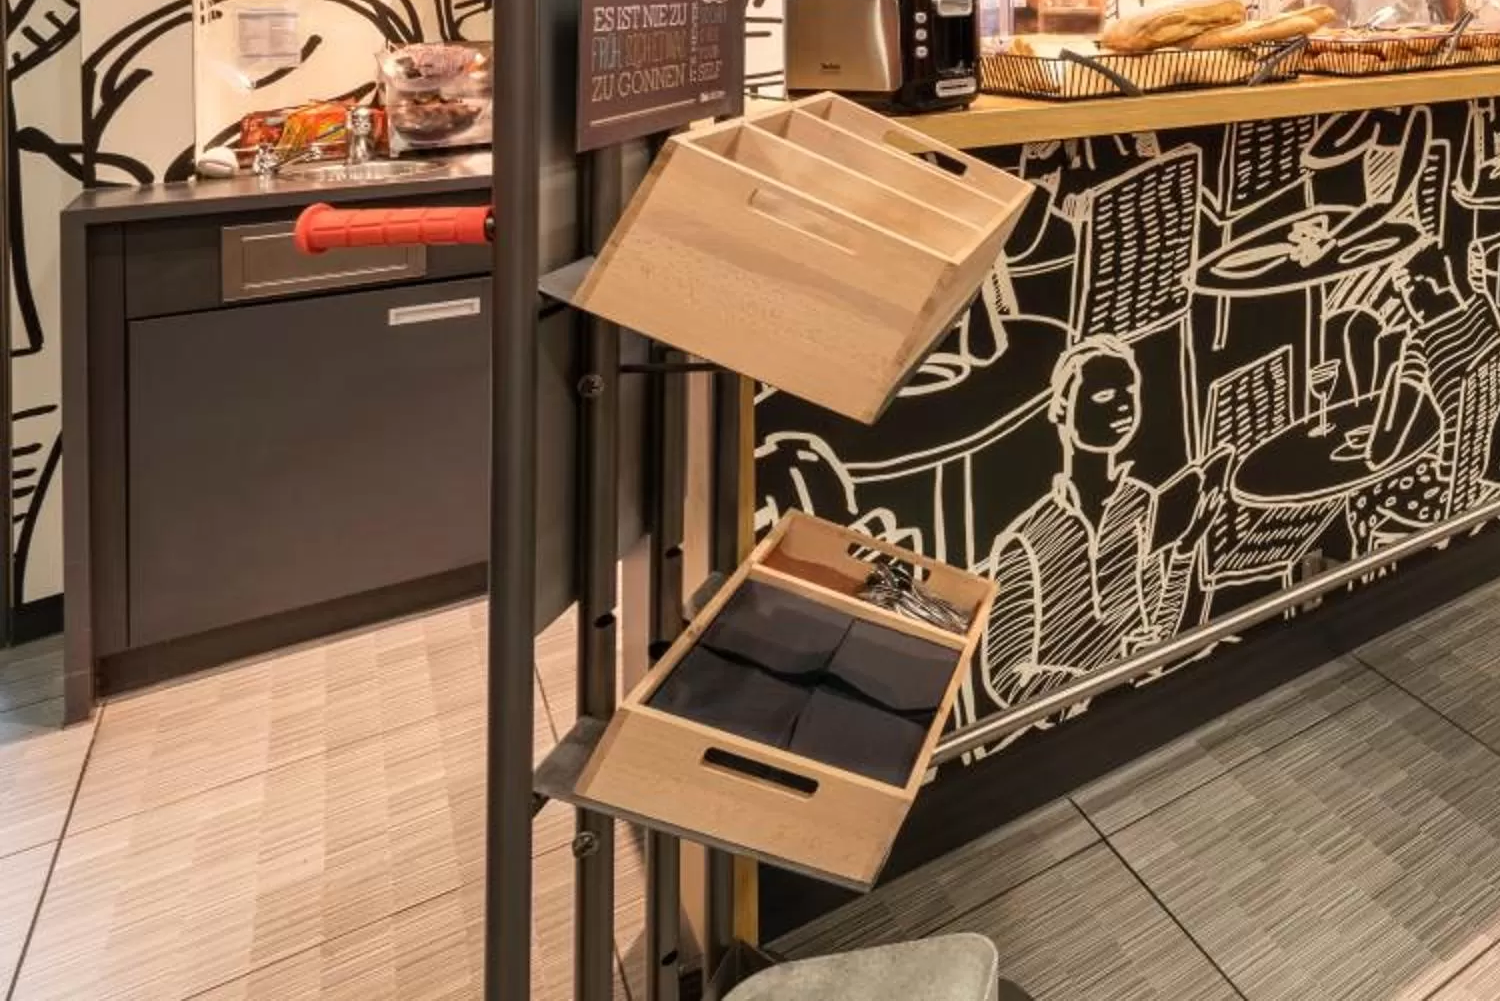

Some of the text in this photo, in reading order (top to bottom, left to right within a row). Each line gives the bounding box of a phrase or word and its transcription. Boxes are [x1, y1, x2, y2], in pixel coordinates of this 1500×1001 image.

[593, 6, 615, 32] ES
[616, 5, 641, 30] IST
[642, 3, 668, 28] NIE
[669, 2, 687, 26] ZU
[591, 74, 615, 102] ZU
